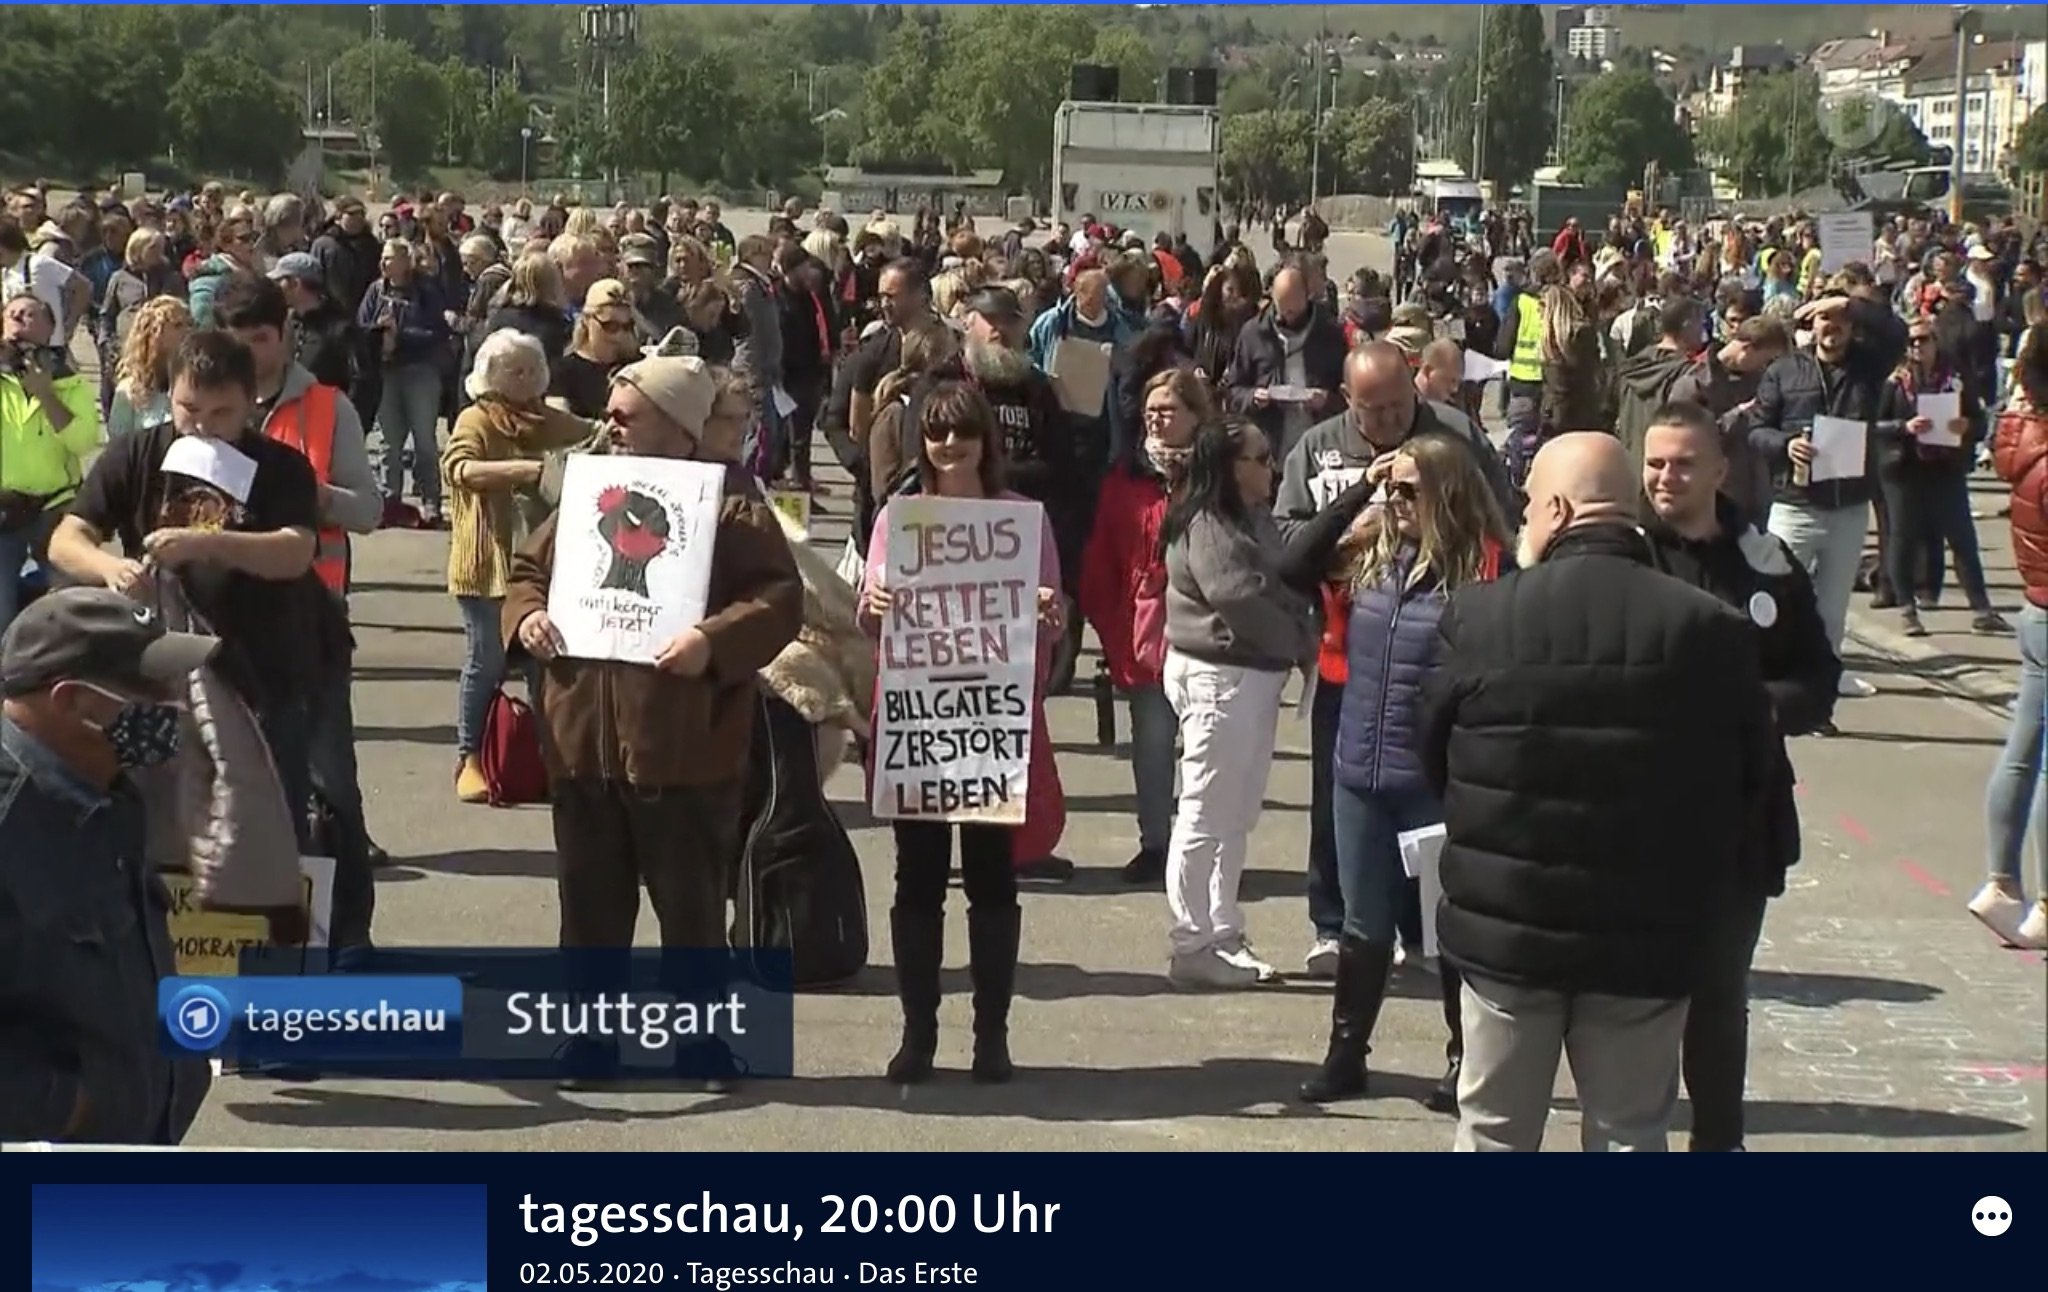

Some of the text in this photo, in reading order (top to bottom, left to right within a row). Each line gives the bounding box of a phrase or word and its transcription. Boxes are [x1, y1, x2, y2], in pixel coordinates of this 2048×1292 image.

[900, 518, 1021, 576] JESUS
[892, 579, 1026, 632] RETTET
[884, 624, 1009, 669] LEBEN
[885, 721, 1029, 770] ZERSTÖRT
[896, 773, 1009, 815] LEBEN
